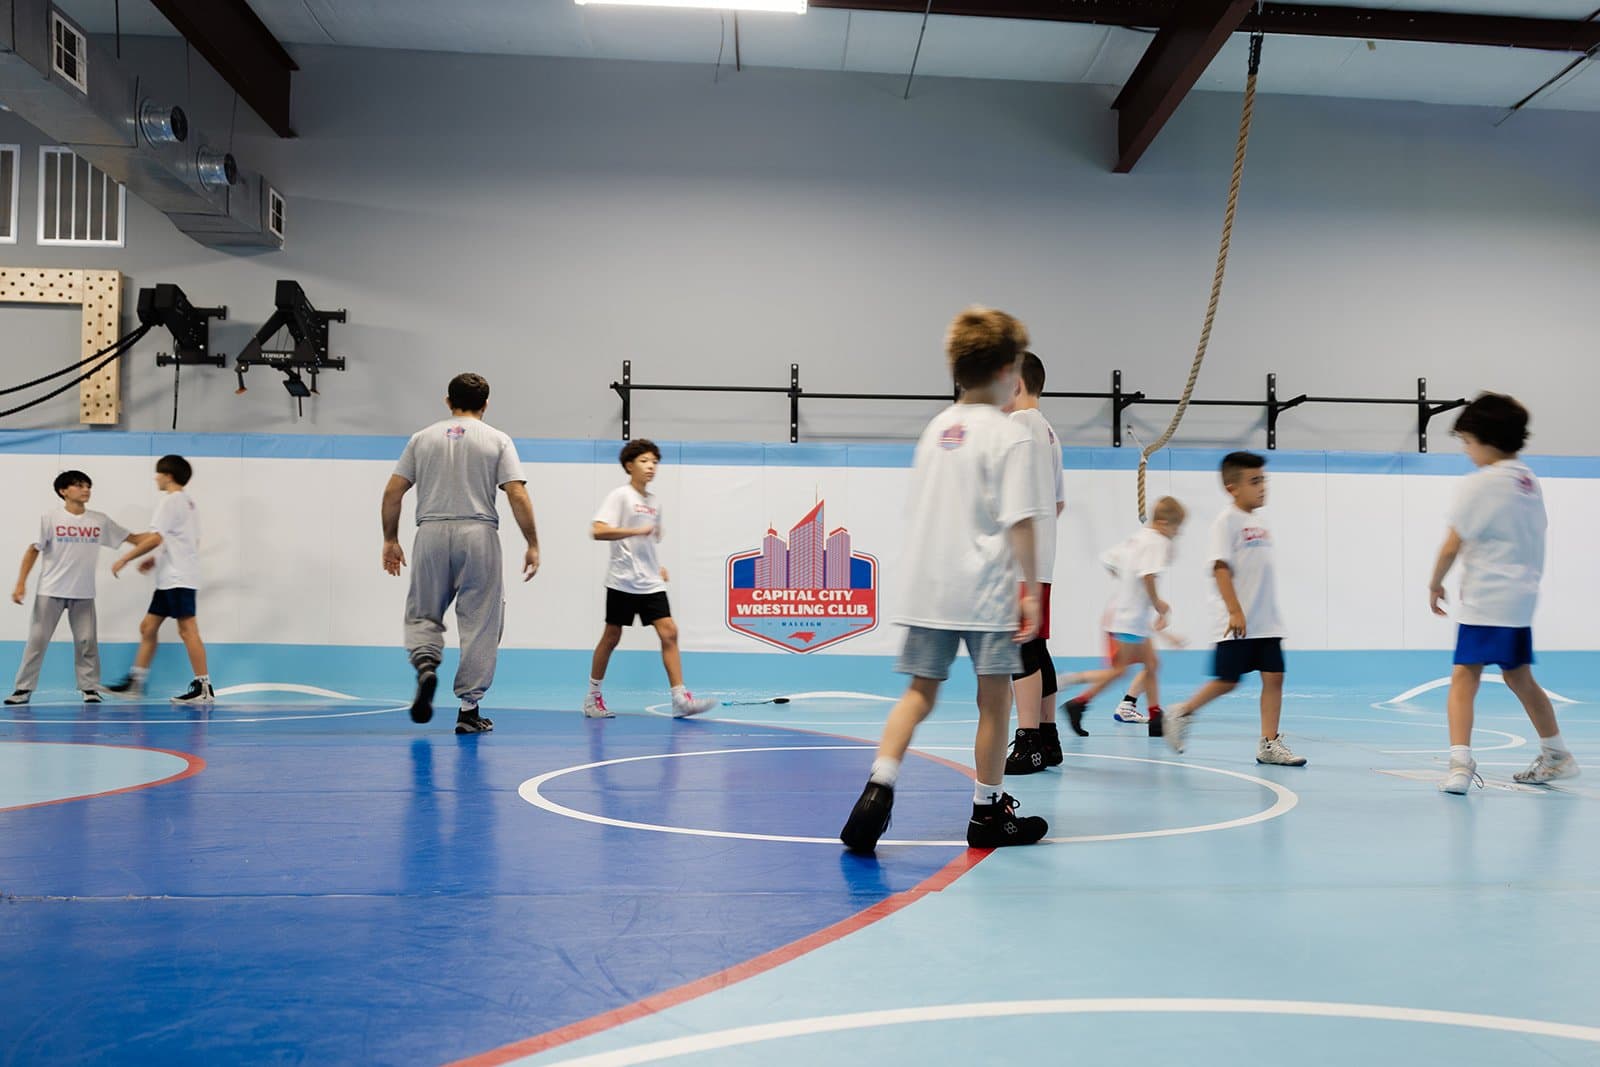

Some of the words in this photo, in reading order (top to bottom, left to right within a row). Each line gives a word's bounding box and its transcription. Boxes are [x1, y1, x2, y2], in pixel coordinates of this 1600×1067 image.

[56, 525, 101, 537] CCWC
[752, 590, 816, 601] CAPITAL
[818, 590, 854, 601] CITY
[736, 604, 825, 615] WRESTLING
[827, 604, 869, 615] CLUB
